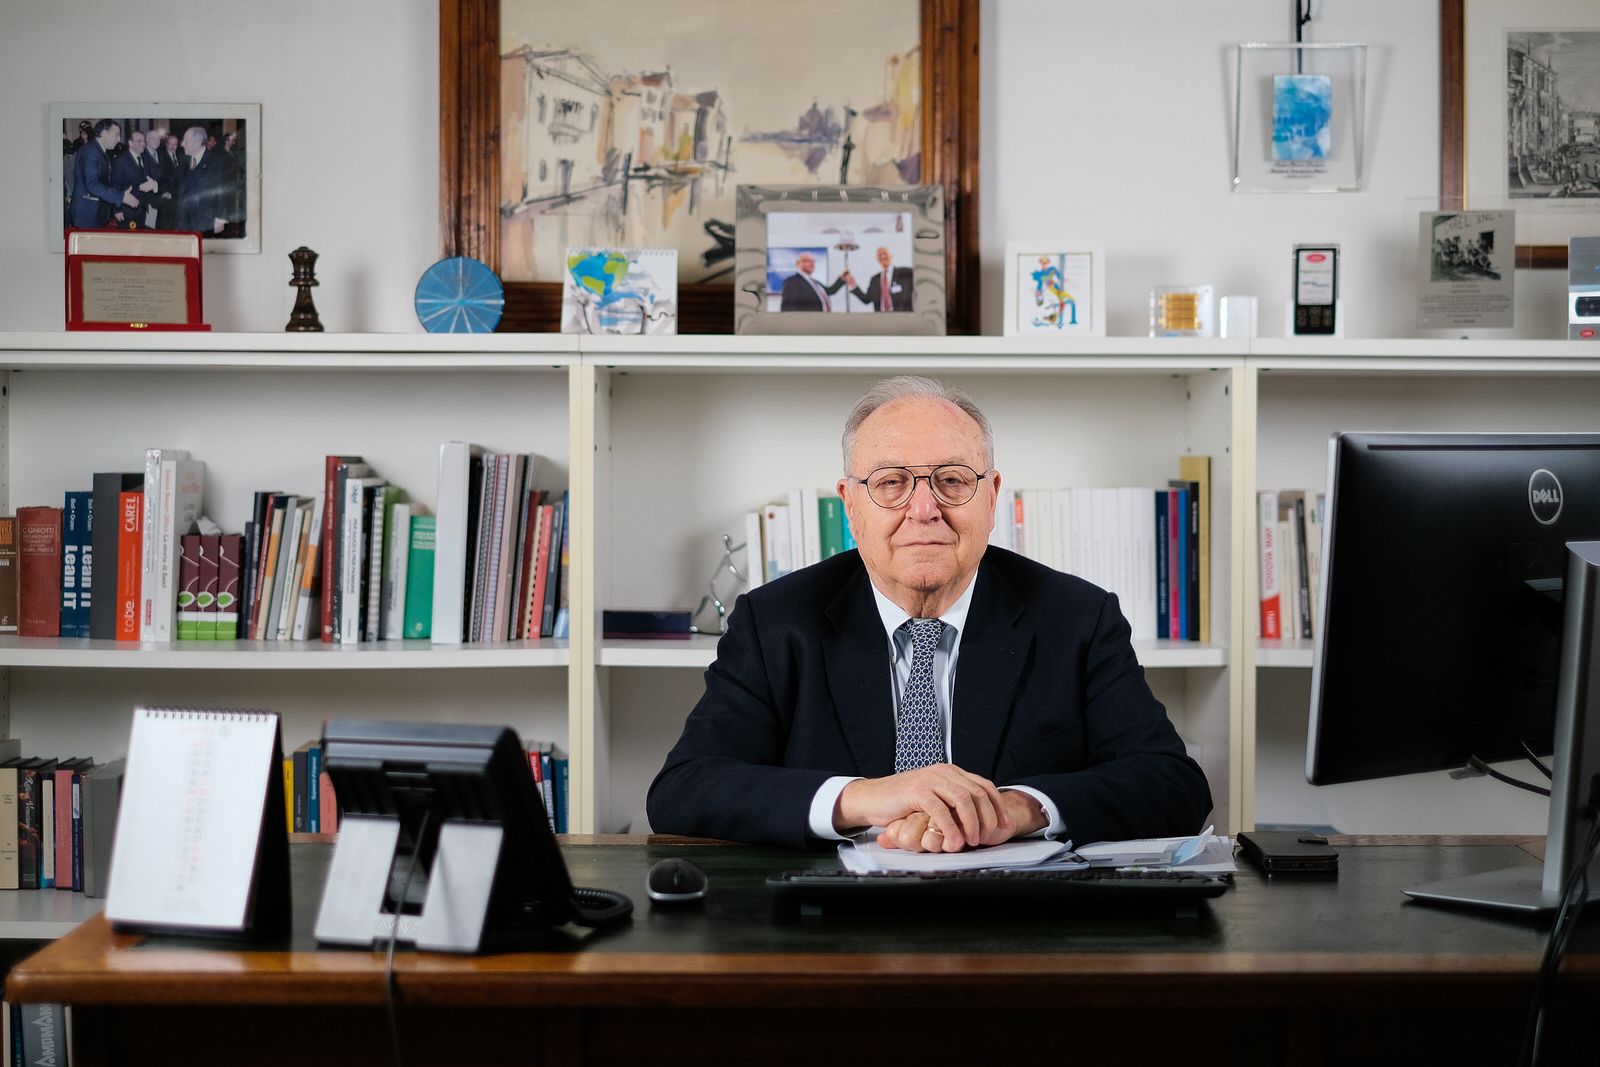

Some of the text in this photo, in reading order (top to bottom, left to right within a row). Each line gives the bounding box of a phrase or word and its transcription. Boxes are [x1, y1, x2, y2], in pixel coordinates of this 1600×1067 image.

[125, 497, 137, 533] CAREL
[1532, 489, 1559, 503] DELL
[63, 545, 78, 610] Lean IT
[81, 545, 93, 588] Lean
